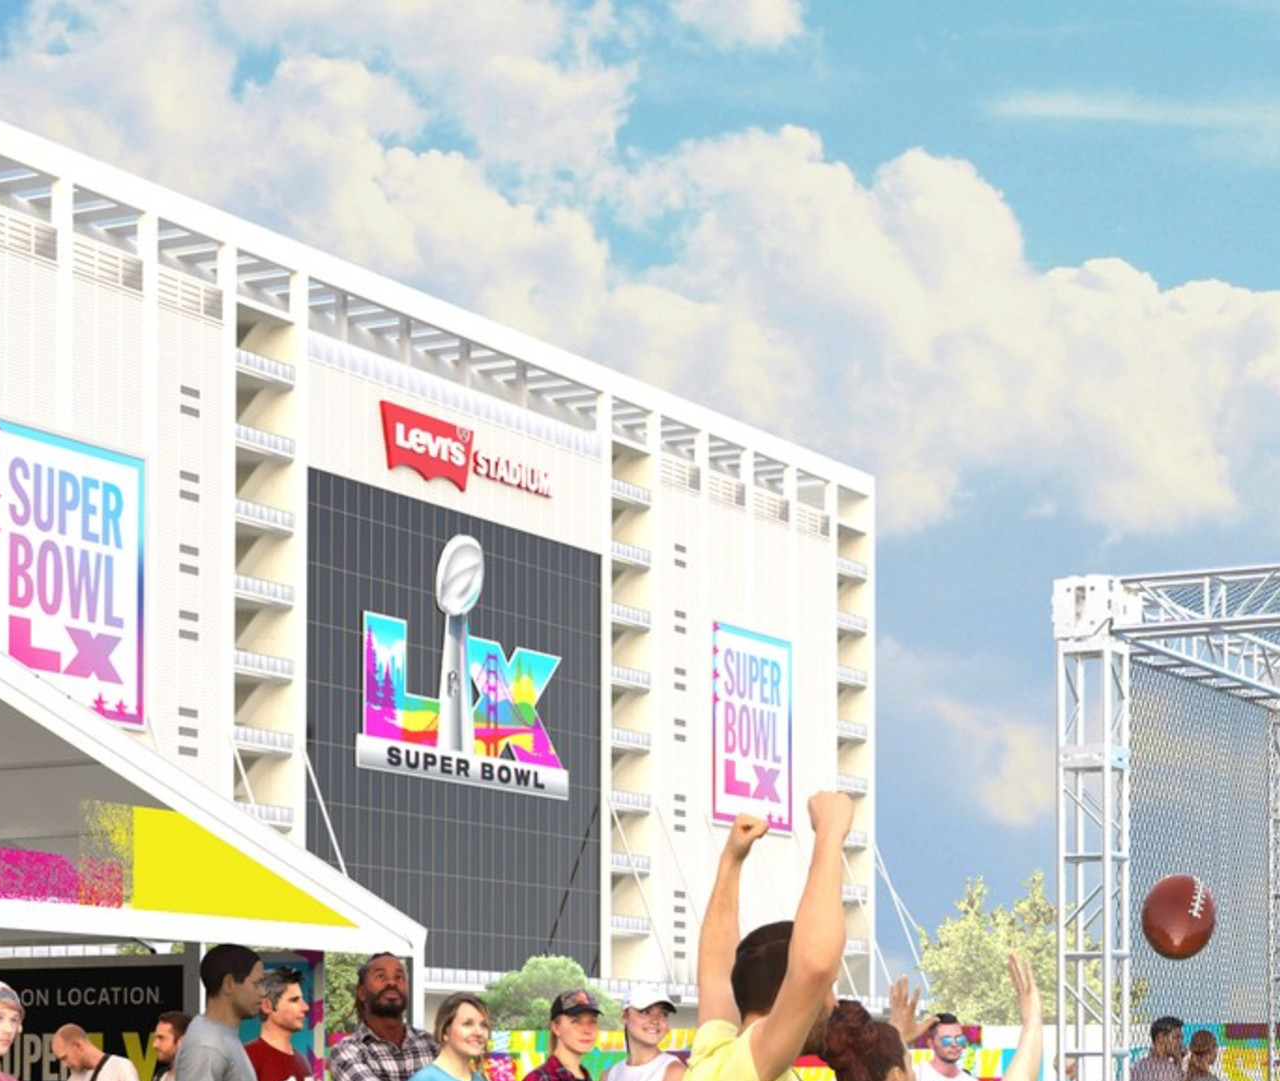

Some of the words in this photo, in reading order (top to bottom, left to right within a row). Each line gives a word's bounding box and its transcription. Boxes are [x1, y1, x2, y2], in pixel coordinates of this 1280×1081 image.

[8, 456, 124, 550] SUPER
[472, 448, 553, 499] STADIUM
[8, 531, 124, 630] BOWL
[8, 613, 124, 685] LX
[724, 647, 782, 708] SUPER
[724, 701, 782, 765] BOWL
[387, 745, 471, 778] SUPER
[480, 762, 546, 790] BOWL
[724, 758, 782, 805] LX
[20, 988, 50, 1006] ON
[56, 986, 160, 1006] LOCATION
